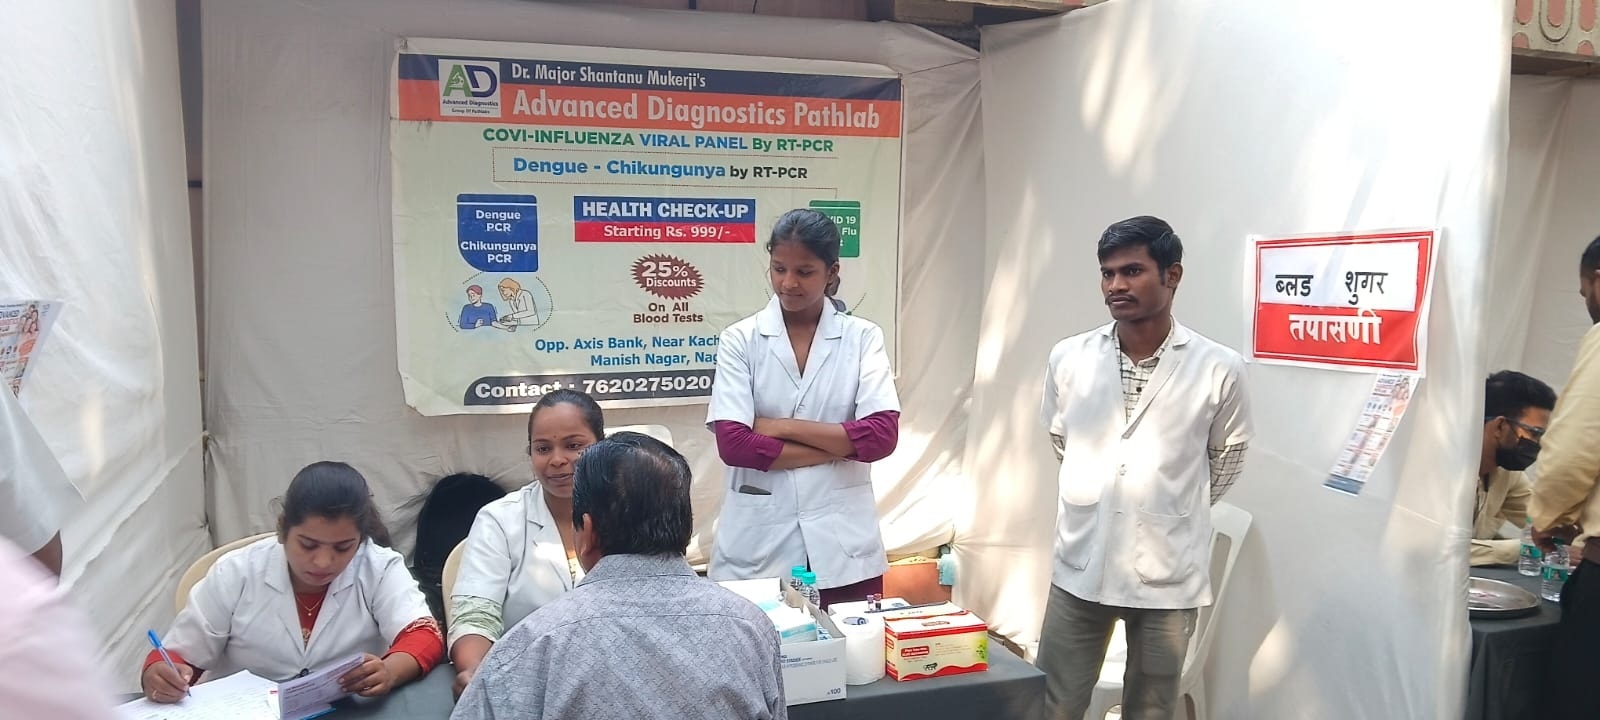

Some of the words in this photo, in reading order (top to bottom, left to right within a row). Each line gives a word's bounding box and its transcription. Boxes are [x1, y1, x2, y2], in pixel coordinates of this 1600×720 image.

[511, 62, 530, 79] Dr.
[535, 63, 576, 84] Major
[580, 66, 643, 84] Shantanu
[647, 70, 706, 90] Mukerji's
[512, 88, 638, 120] Advanced
[647, 95, 786, 129] Diagnostics
[794, 101, 880, 129] Pathlab
[482, 127, 635, 146] COVI-INFLUENZA
[640, 133, 690, 148] VIRAL
[695, 135, 748, 150] PANEL
[752, 137, 771, 153] By
[777, 138, 834, 152] RT-PCR
[513, 157, 589, 176] Dengue
[606, 159, 725, 179] Chikungunya
[730, 165, 748, 180] by
[753, 165, 808, 179] RT-PCR
[475, 209, 521, 222] Dengue
[582, 201, 652, 217] HEALTH
[657, 202, 749, 219] CHECK-UP
[486, 222, 511, 232] PCR
[846, 215, 857, 225] 19
[603, 224, 661, 240] Starting
[665, 226, 687, 238] Rs.
[691, 226, 731, 239] 999/-
[841, 227, 857, 236] Flu
[460, 241, 537, 253] Chikungunya
[487, 253, 512, 263] PCR
[641, 261, 688, 278] 25%
[646, 277, 697, 287] Discounts
[1275, 274, 1314, 297] ब्लड
[1345, 270, 1389, 306] शुगर
[648, 302, 666, 312] On
[672, 301, 689, 312] All
[633, 313, 669, 323] Blood
[672, 313, 704, 323] Tests
[1288, 307, 1383, 345] तपासणी
[535, 338, 569, 353] Opp.
[573, 337, 603, 350] Axis
[607, 336, 647, 350] Bank,
[652, 336, 685, 348] Near
[688, 334, 720, 347] Kach
[591, 353, 641, 367] Manish
[645, 353, 691, 367] Nagar,
[694, 351, 718, 365] Nag
[475, 381, 562, 398] Contact
